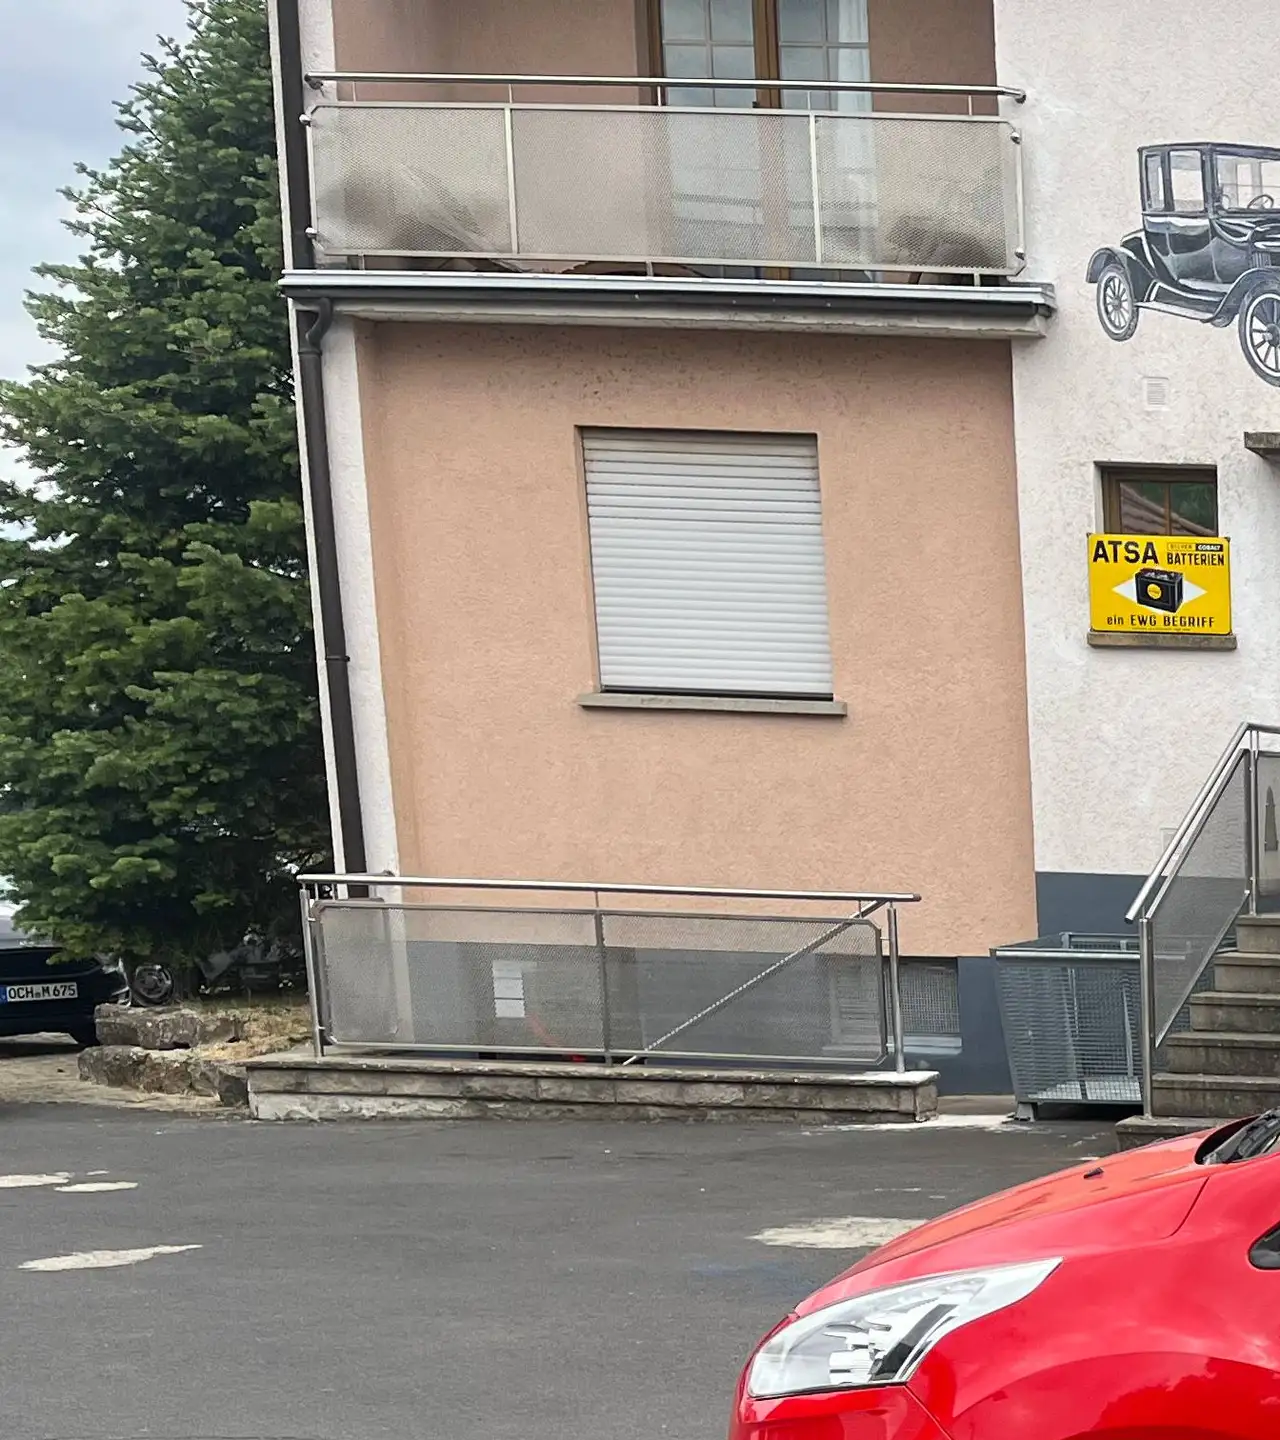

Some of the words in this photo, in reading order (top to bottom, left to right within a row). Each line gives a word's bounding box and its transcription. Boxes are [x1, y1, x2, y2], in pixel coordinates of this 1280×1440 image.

[1092, 540, 1159, 564] ATSA
[1166, 552, 1225, 566] BATTERIEN
[1106, 615, 1124, 625] ein
[1130, 614, 1157, 626] EWG
[1163, 616, 1215, 628] BEGRIFF
[8, 986, 34, 999] OCH
[53, 984, 76, 997] 675
